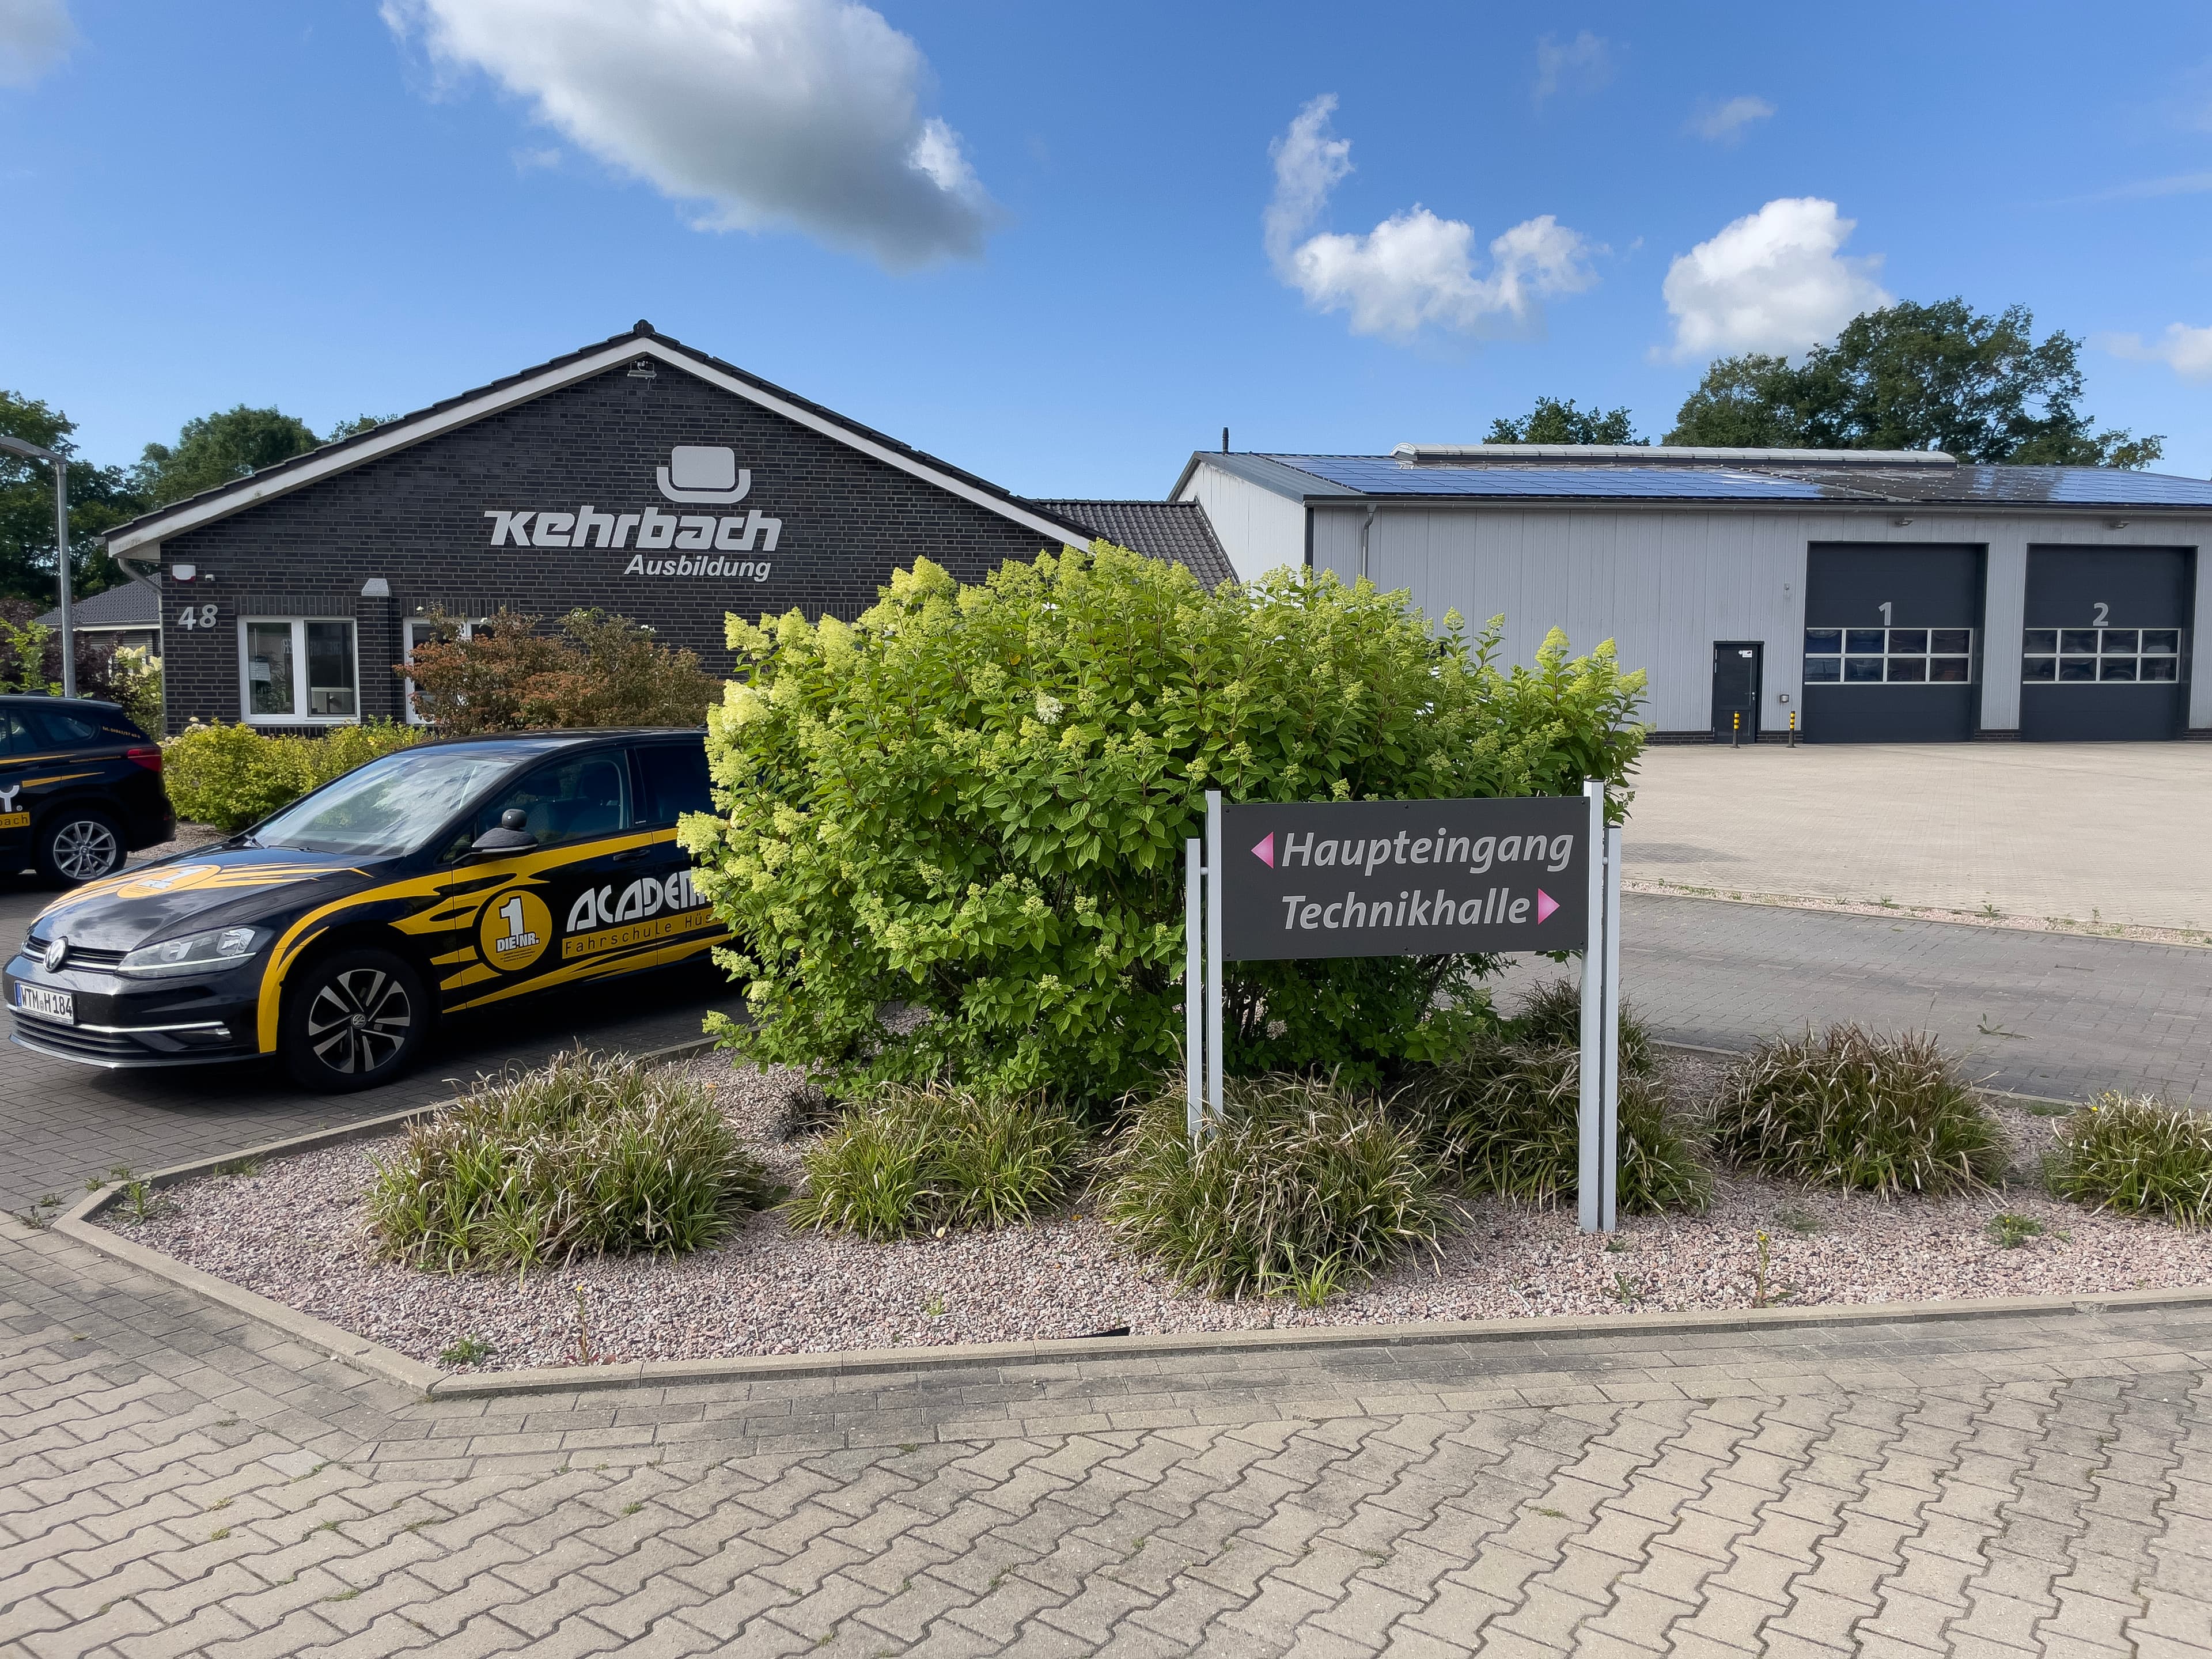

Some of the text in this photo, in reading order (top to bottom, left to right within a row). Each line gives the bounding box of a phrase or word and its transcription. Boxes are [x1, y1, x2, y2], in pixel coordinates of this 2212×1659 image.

[624, 554, 771, 582] Ausbildung
[178, 604, 218, 630] 48
[1878, 602, 1891, 626] 1
[2093, 603, 2108, 626] 2
[1282, 828, 1573, 876] Haupteingang
[566, 870, 705, 932] ACADEM
[1282, 888, 1531, 929] Technikhalle
[497, 932, 540, 953] DIE NR.
[565, 922, 672, 955] Fahrschule
[21, 987, 39, 1009] WTM
